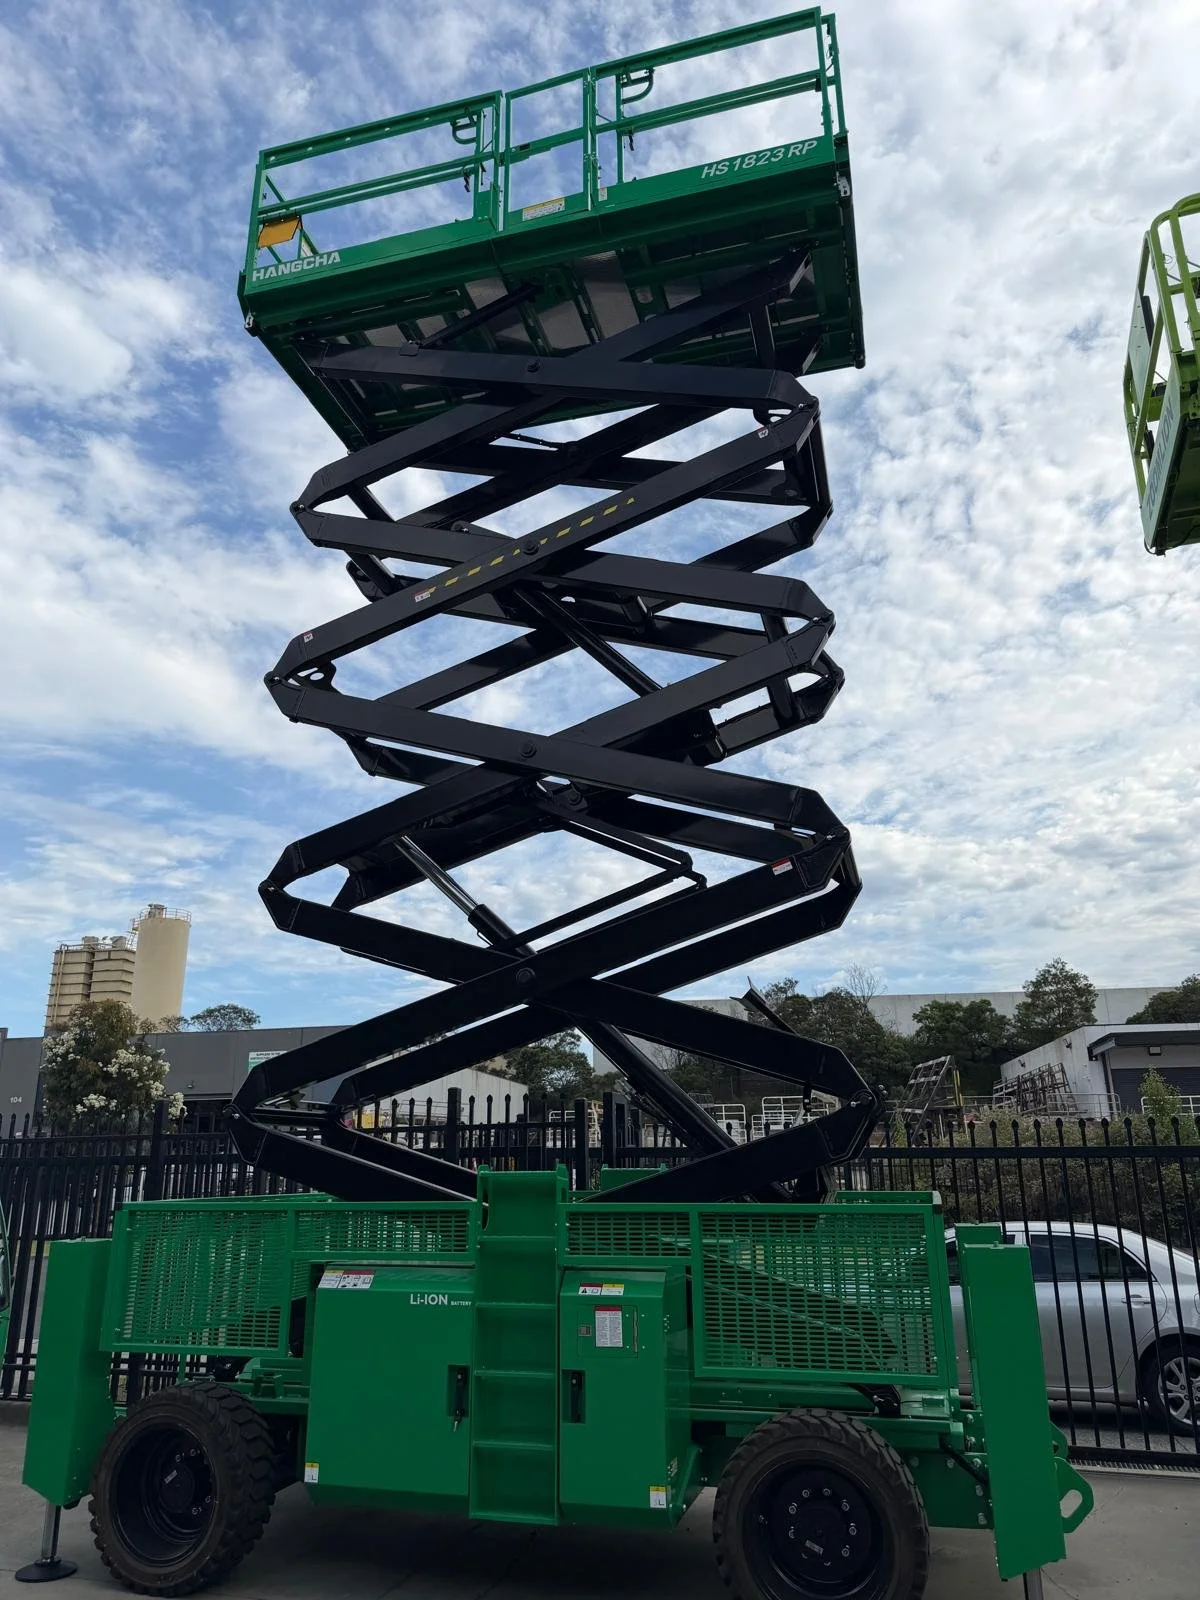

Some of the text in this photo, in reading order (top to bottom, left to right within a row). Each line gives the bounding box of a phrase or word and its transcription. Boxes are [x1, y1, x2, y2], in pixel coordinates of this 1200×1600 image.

[252, 251, 341, 282] HANGCHA
[1147, 396, 1174, 521] ZOOMLION
[10, 1096, 22, 1104] 104
[410, 1293, 449, 1306] Li-ION
